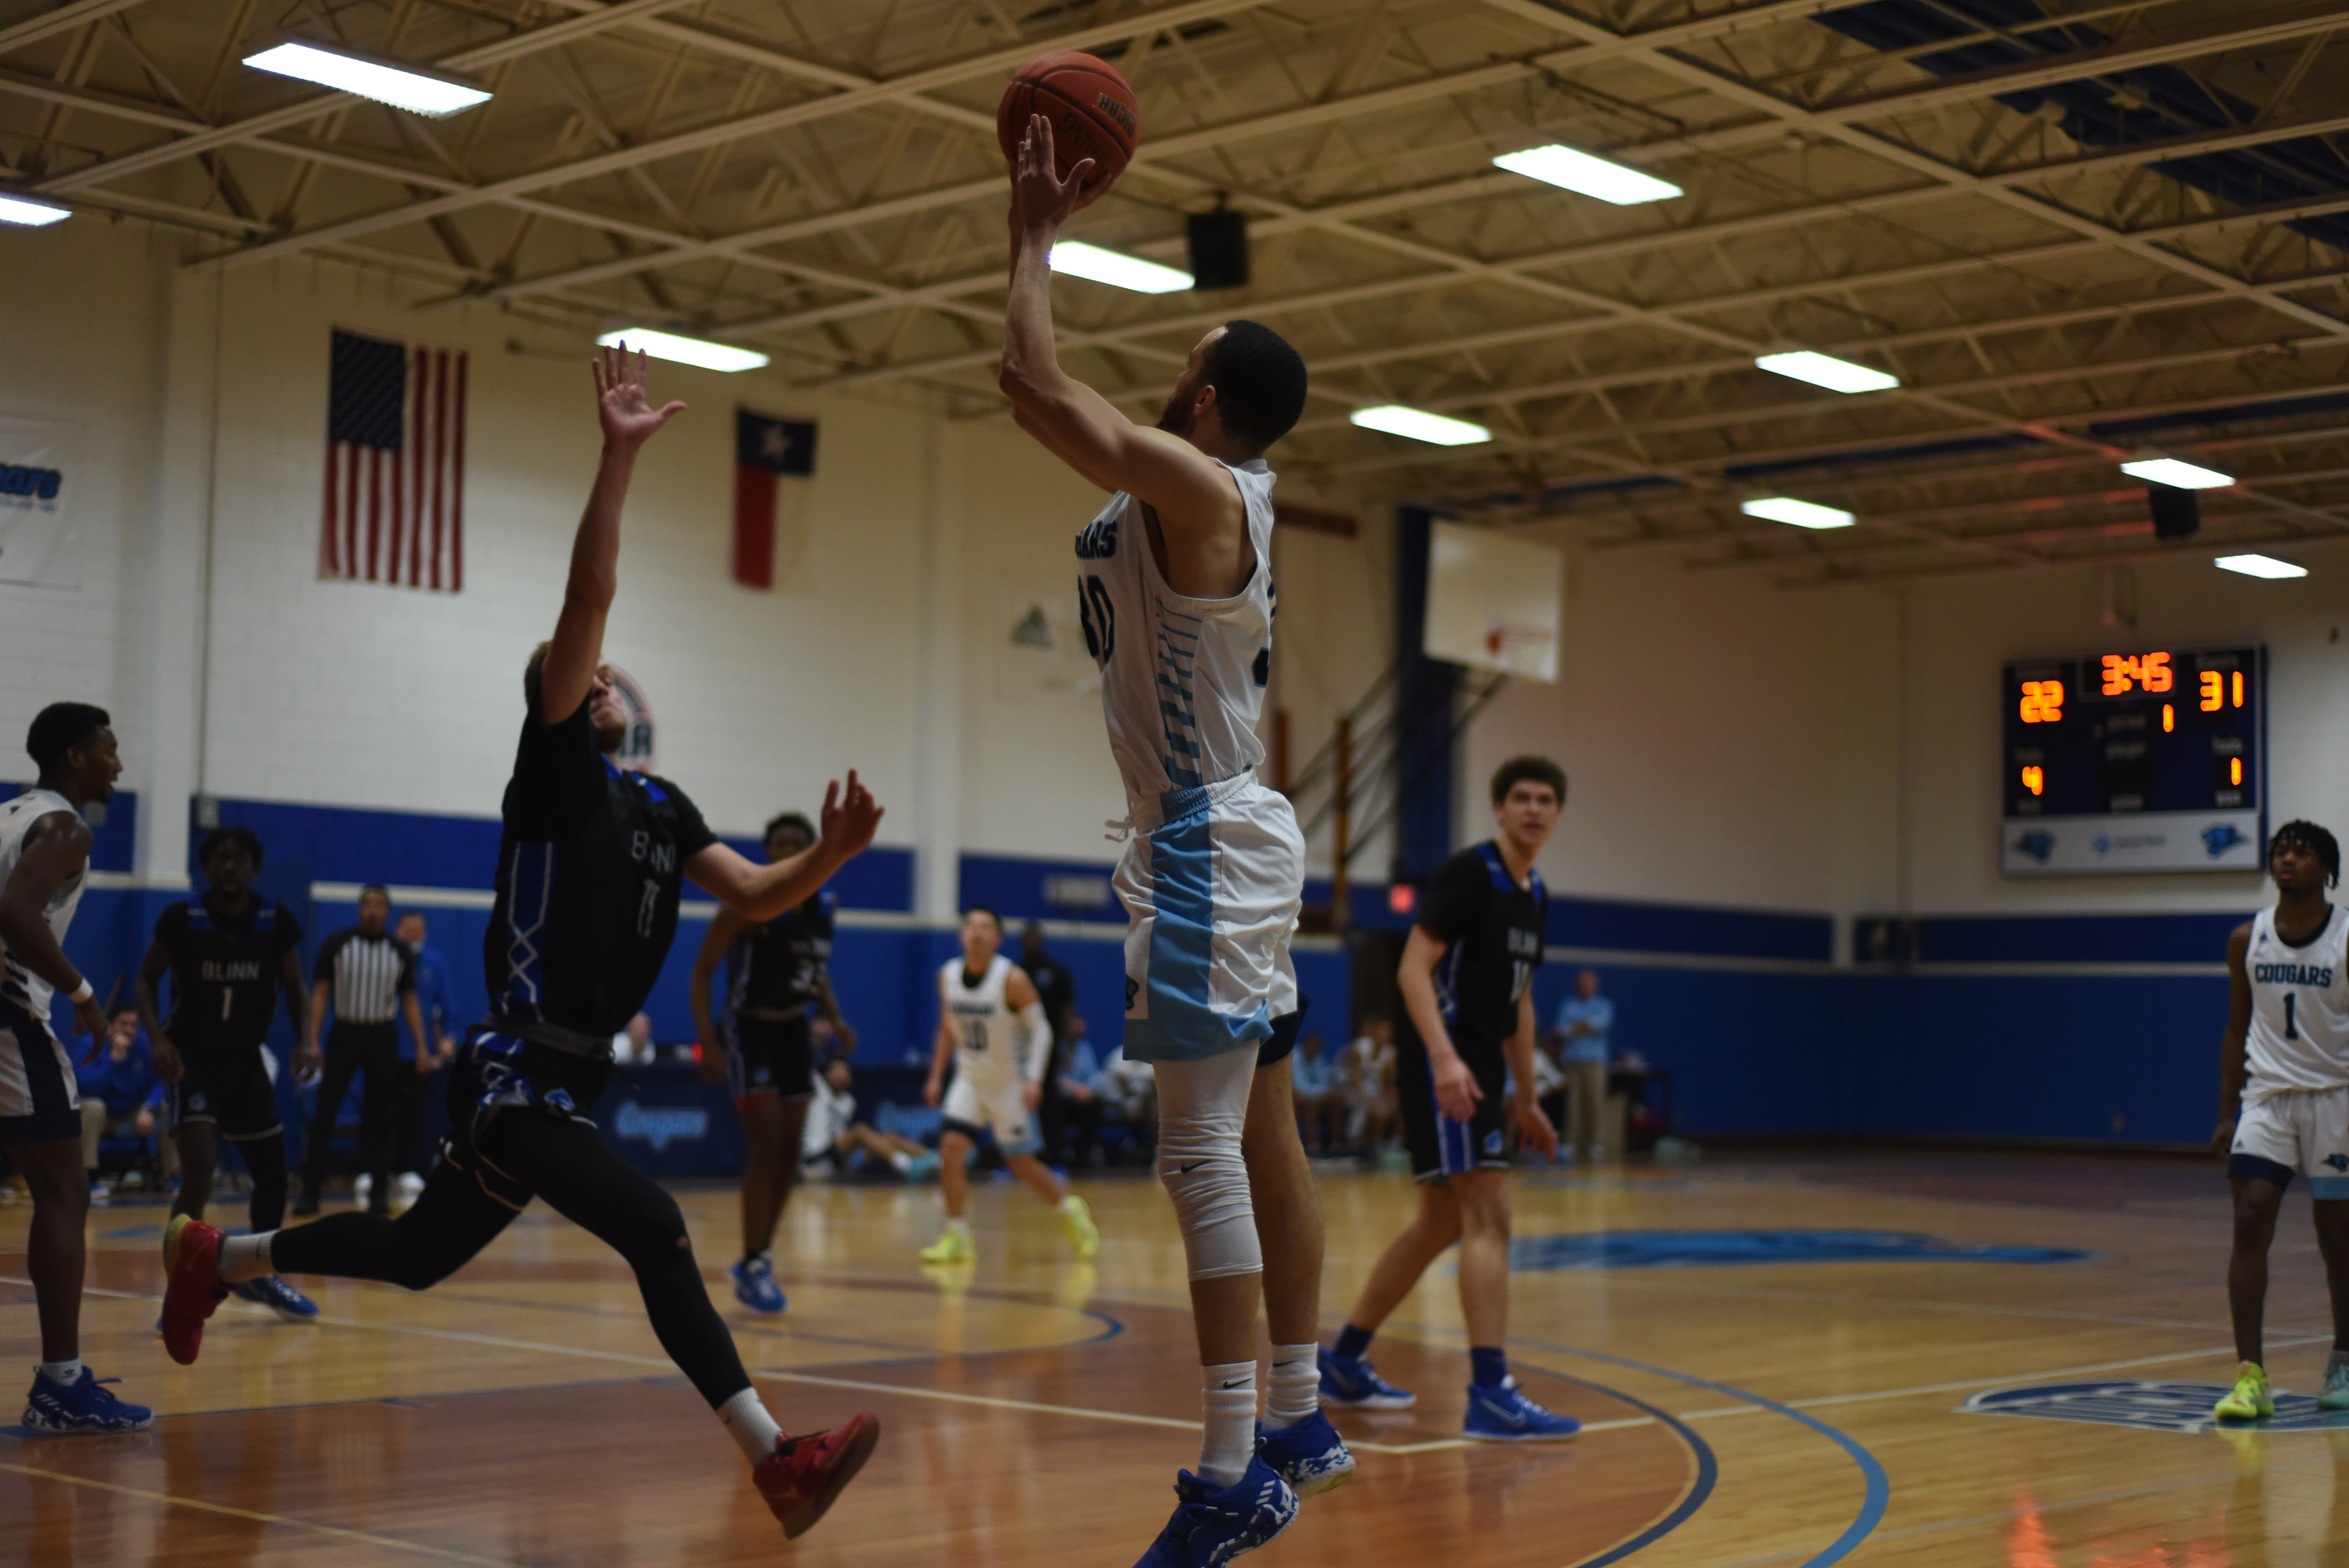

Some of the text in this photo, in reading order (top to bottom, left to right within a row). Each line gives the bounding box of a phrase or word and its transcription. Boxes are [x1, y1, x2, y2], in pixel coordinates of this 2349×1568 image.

[2101, 651, 2173, 696] 3:45
[2199, 669, 2244, 713] 31
[2019, 679, 2065, 724] 22
[202, 960, 260, 981] BLINN
[2255, 963, 2333, 989] COUGARS
[221, 986, 233, 1021] 1
[2283, 992, 2299, 1040] 1
